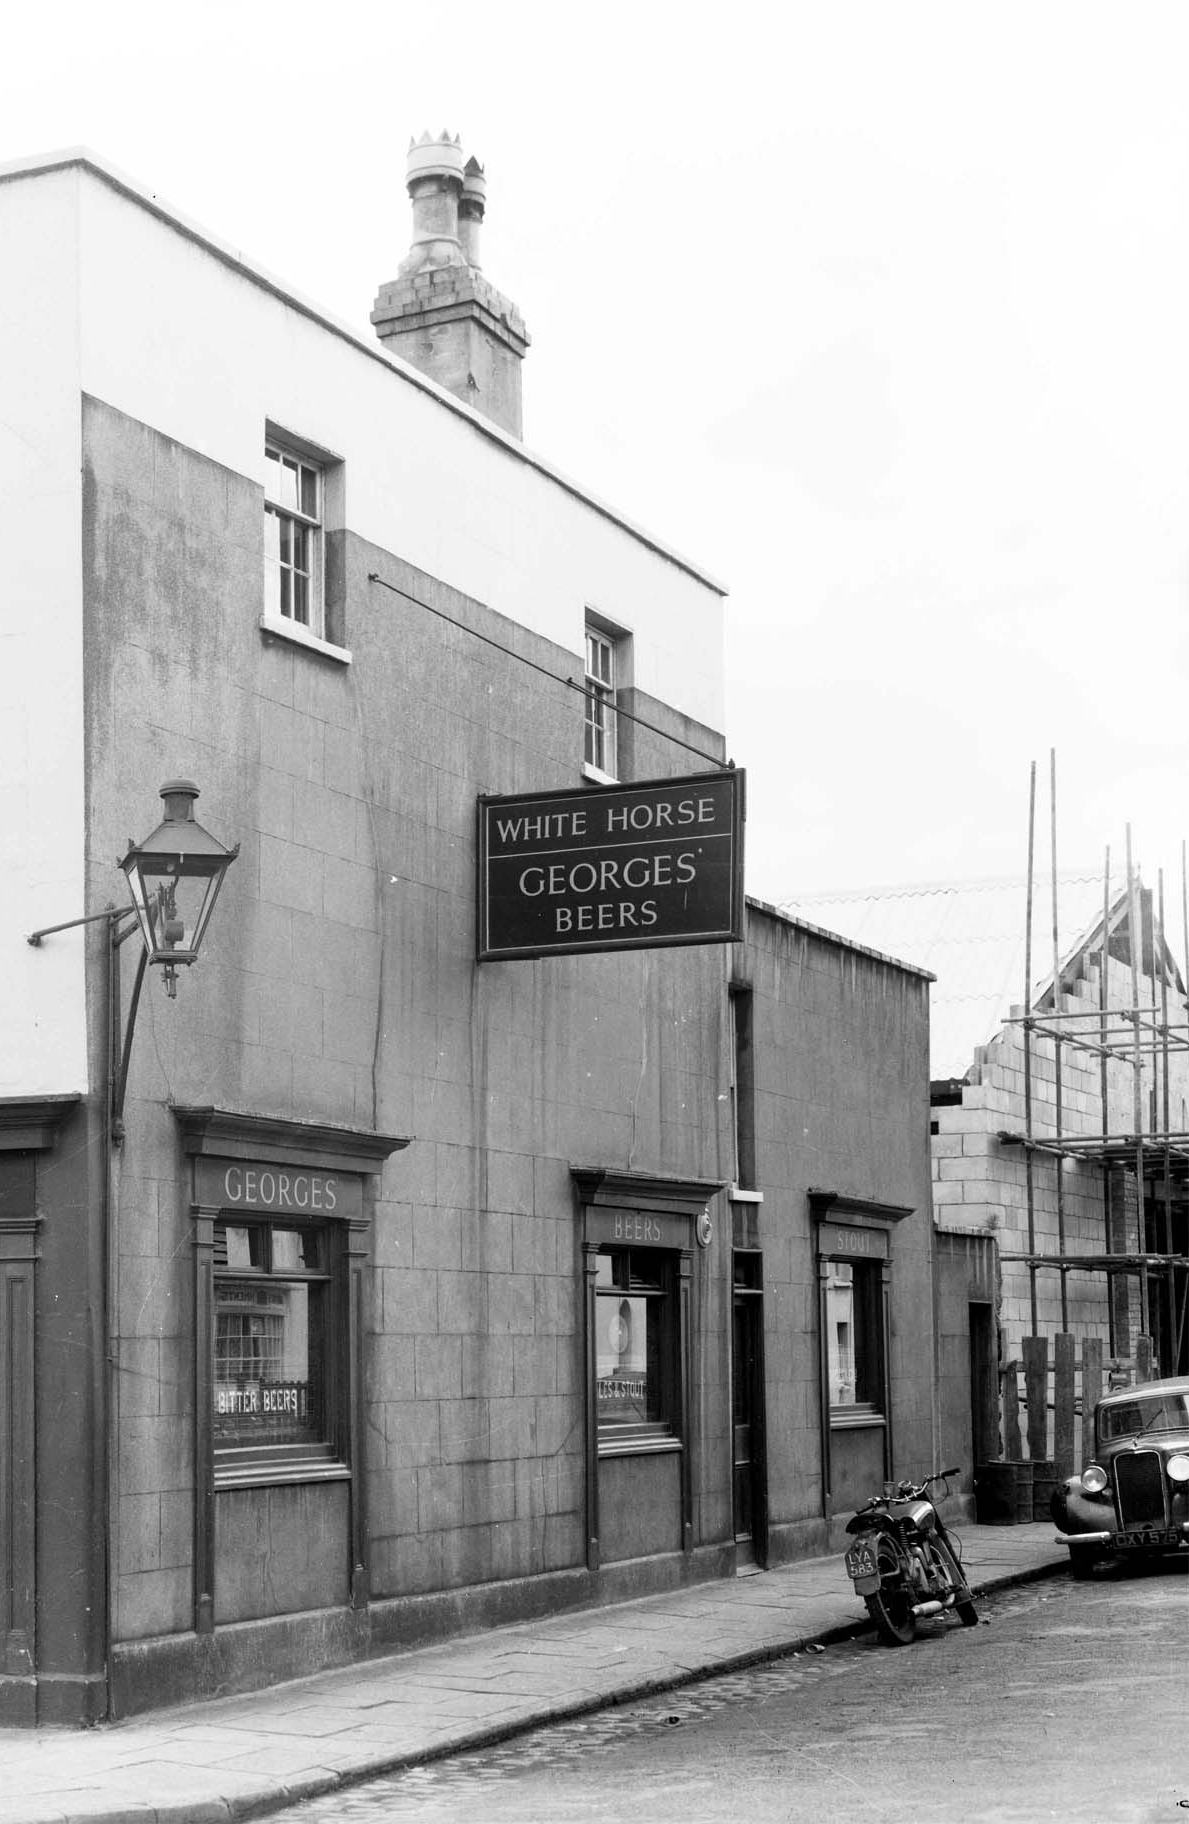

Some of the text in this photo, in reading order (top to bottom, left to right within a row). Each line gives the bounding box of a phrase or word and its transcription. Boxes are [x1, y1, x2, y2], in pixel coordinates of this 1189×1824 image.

[497, 798, 715, 843] WHITE HORSE
[555, 900, 658, 933] BEERS
[614, 1214, 661, 1241] BEERS
[218, 1389, 298, 1414] BITTER BEERS
[848, 1551, 872, 1565] LYA
[850, 1562, 874, 1576] 583
